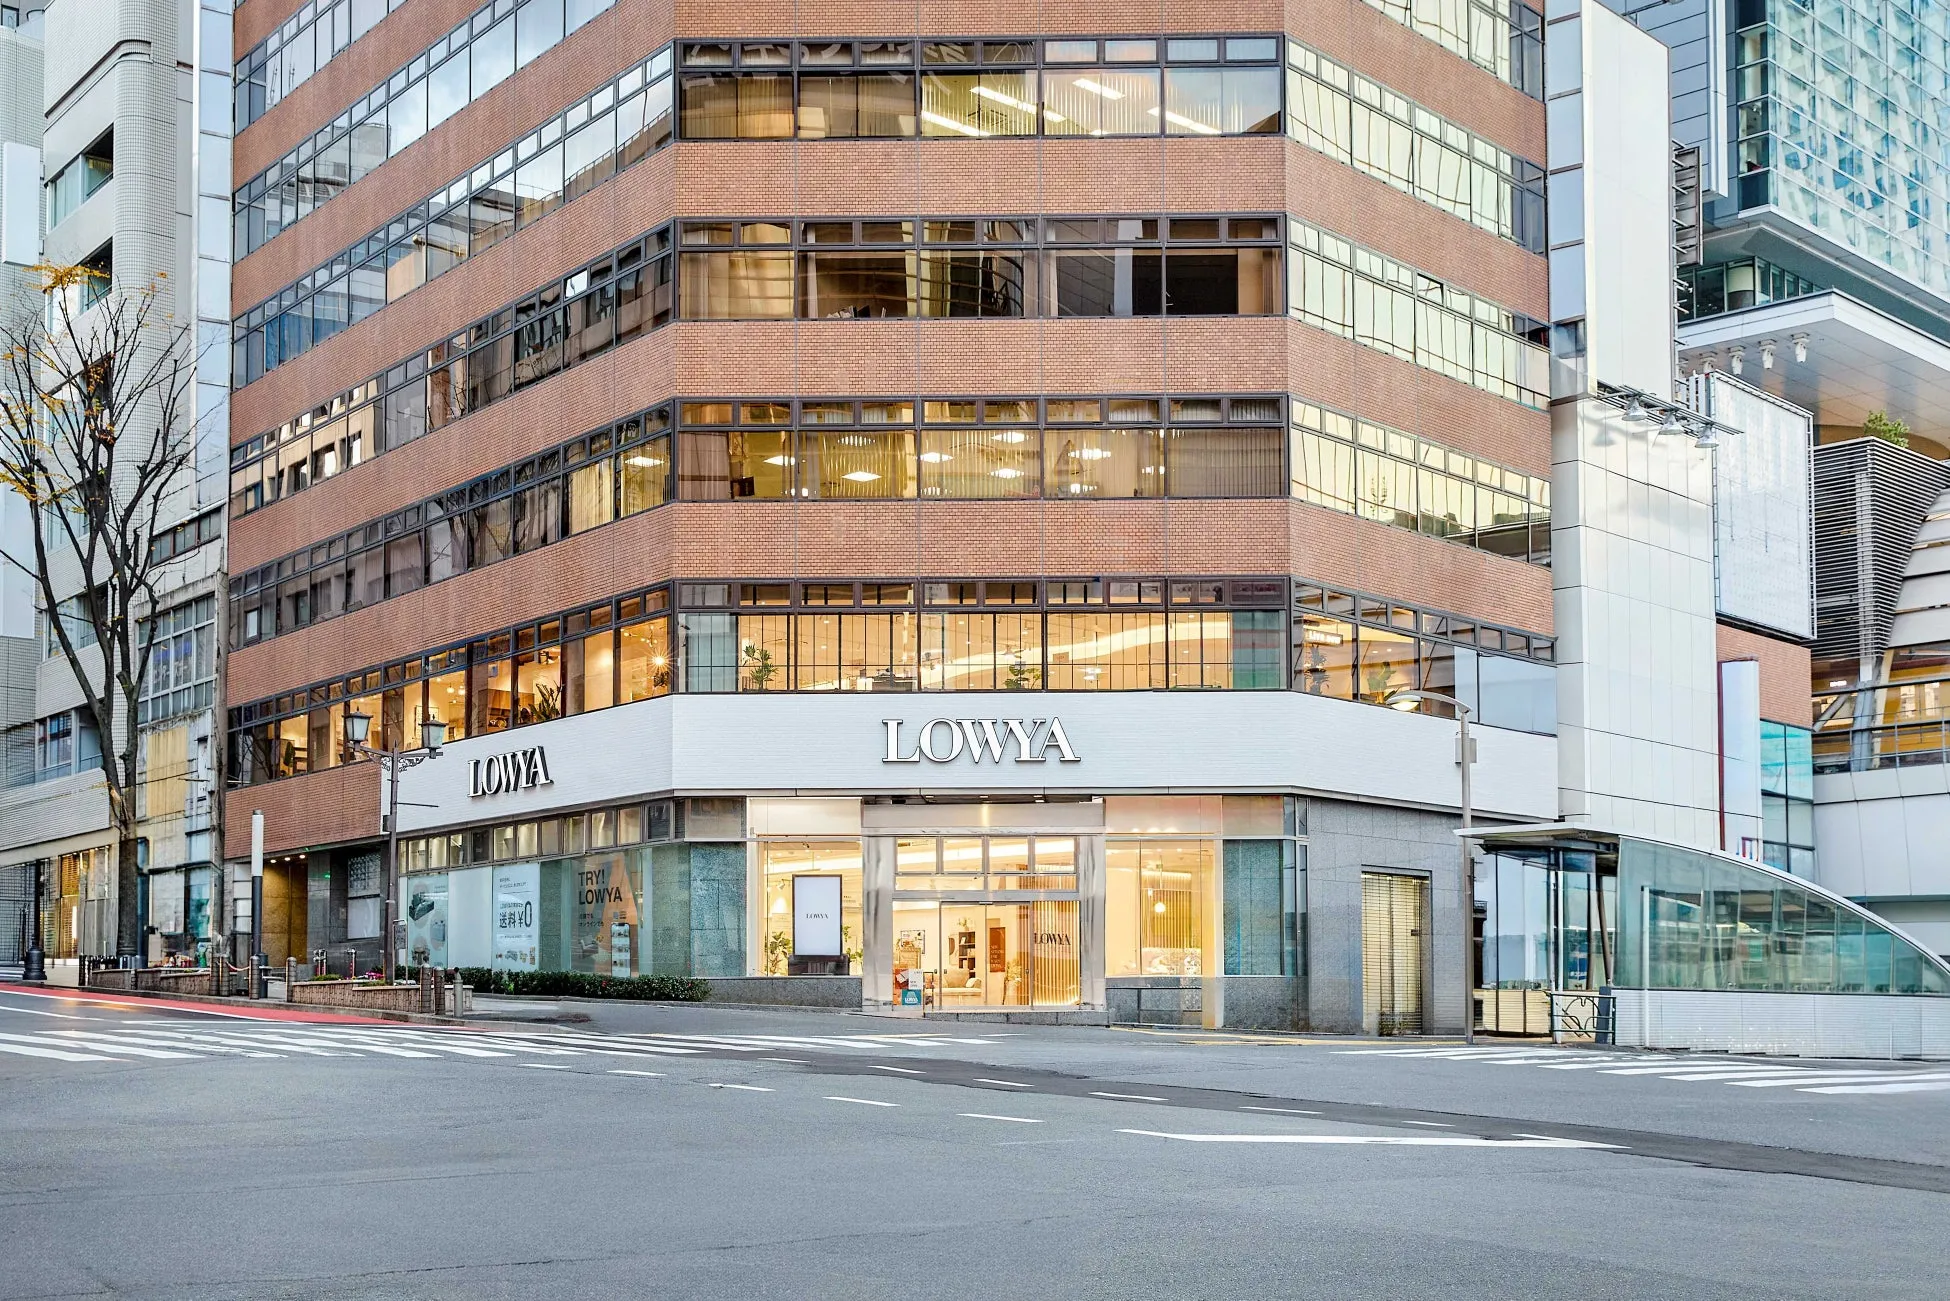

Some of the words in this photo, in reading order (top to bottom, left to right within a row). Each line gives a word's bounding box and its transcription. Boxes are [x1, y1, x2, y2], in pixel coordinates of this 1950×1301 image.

[882, 717, 1081, 763] LOWYA
[467, 746, 554, 797] LOWYA
[578, 869, 605, 886] TRY!
[578, 887, 622, 905] LOWYA
[1034, 932, 1071, 945] LOWYA
